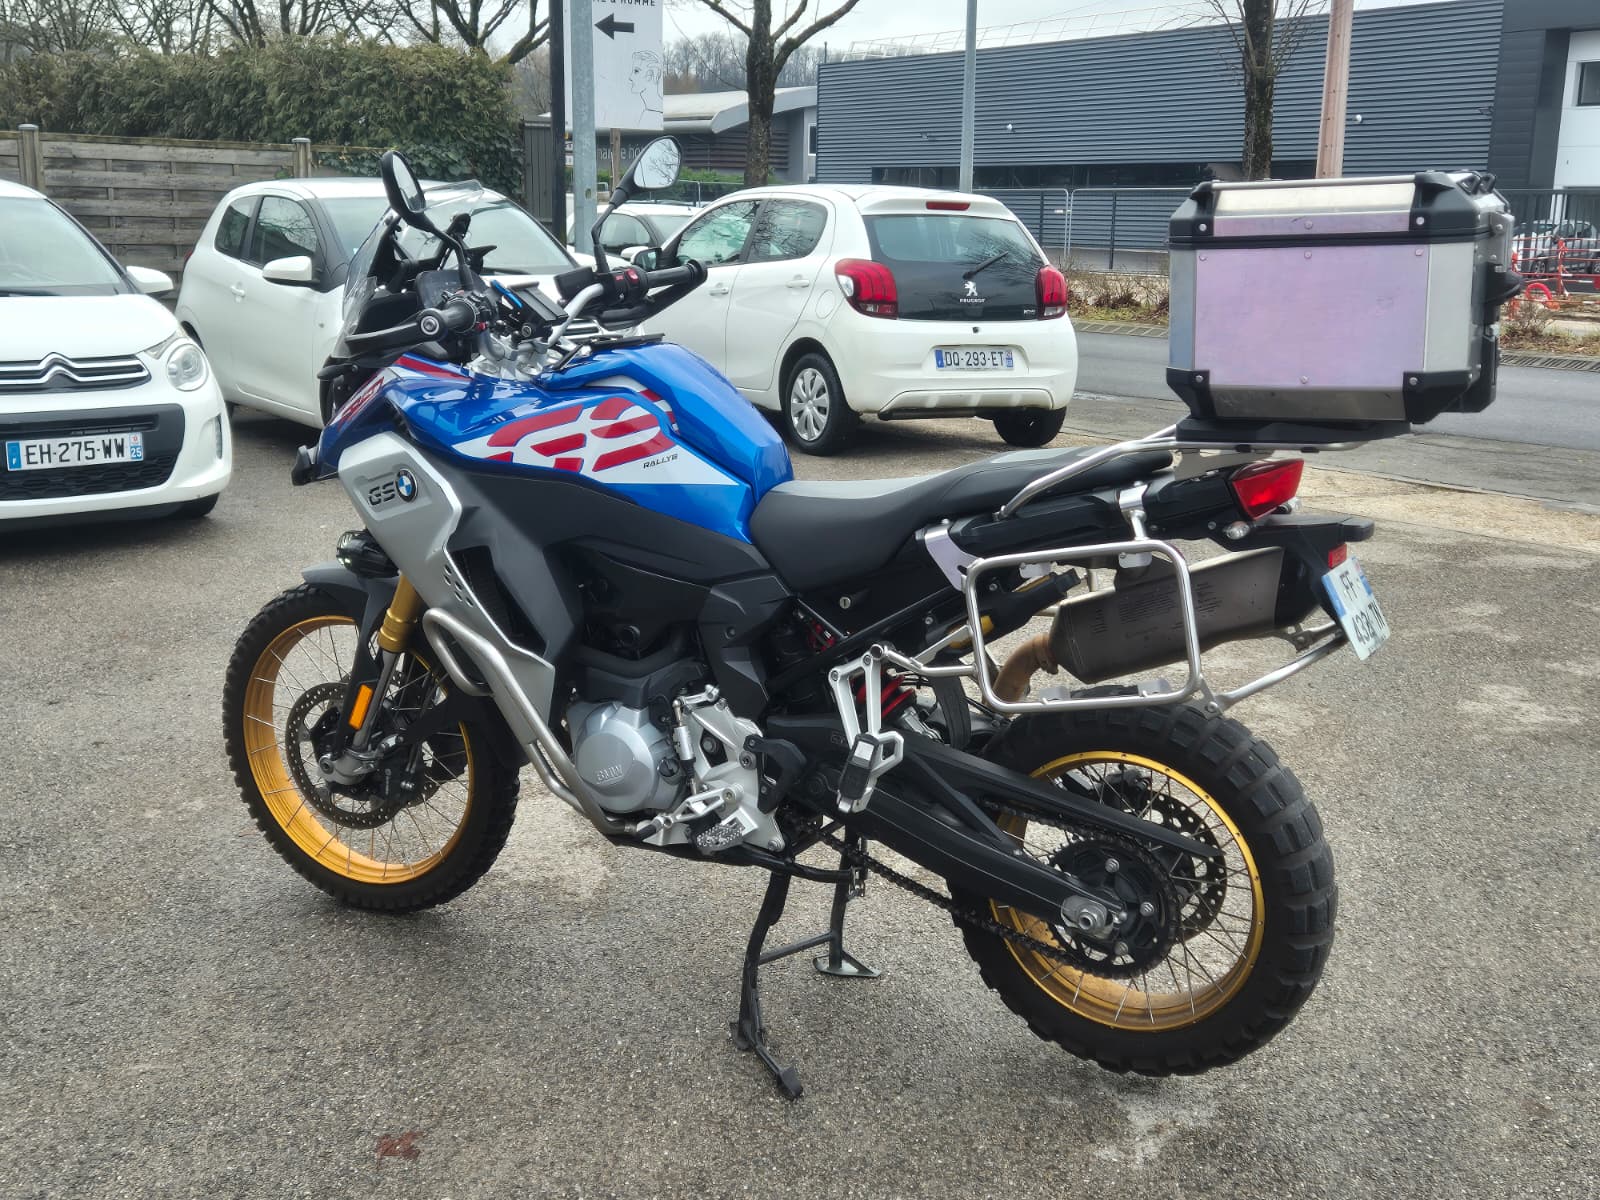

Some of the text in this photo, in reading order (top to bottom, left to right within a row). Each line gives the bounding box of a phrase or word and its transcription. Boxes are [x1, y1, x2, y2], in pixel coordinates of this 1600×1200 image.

[25, 438, 125, 465] EH-275-WW
[643, 453, 678, 469] RALLYE
[369, 481, 395, 506] GS
